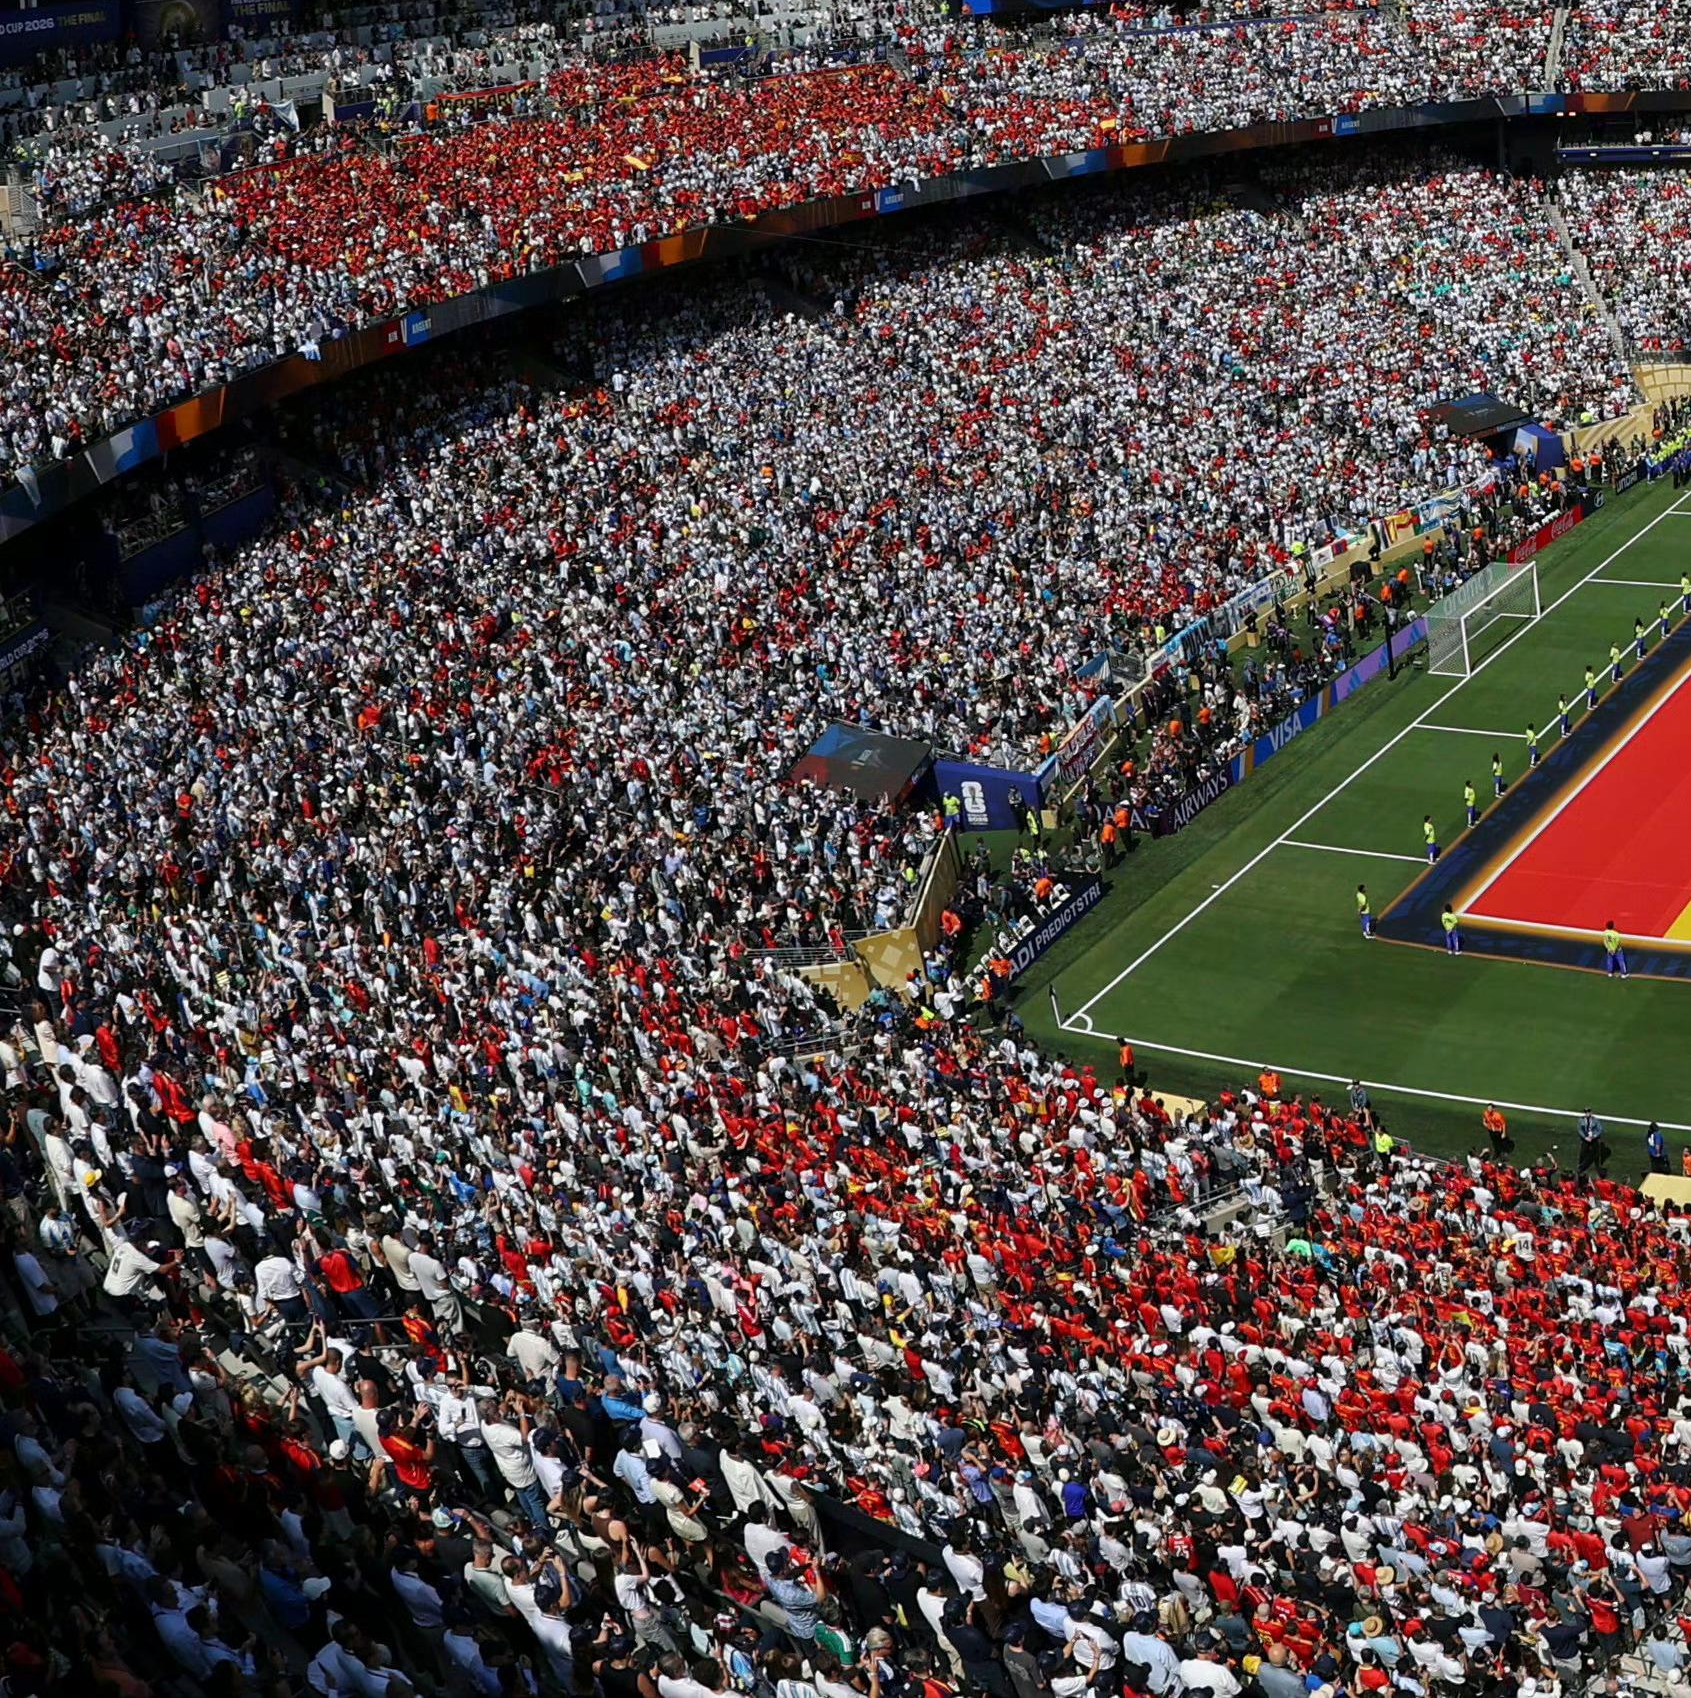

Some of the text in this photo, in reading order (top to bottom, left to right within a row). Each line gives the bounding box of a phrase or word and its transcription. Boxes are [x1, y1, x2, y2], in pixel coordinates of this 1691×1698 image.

[6, 21, 25, 35] CUP
[25, 16, 55, 32] 2026
[1265, 710, 1303, 751] VISA
[1172, 768, 1229, 830] AIRWAYS
[1008, 939, 1036, 981] ADI
[1517, 1239, 1530, 1251] 14
